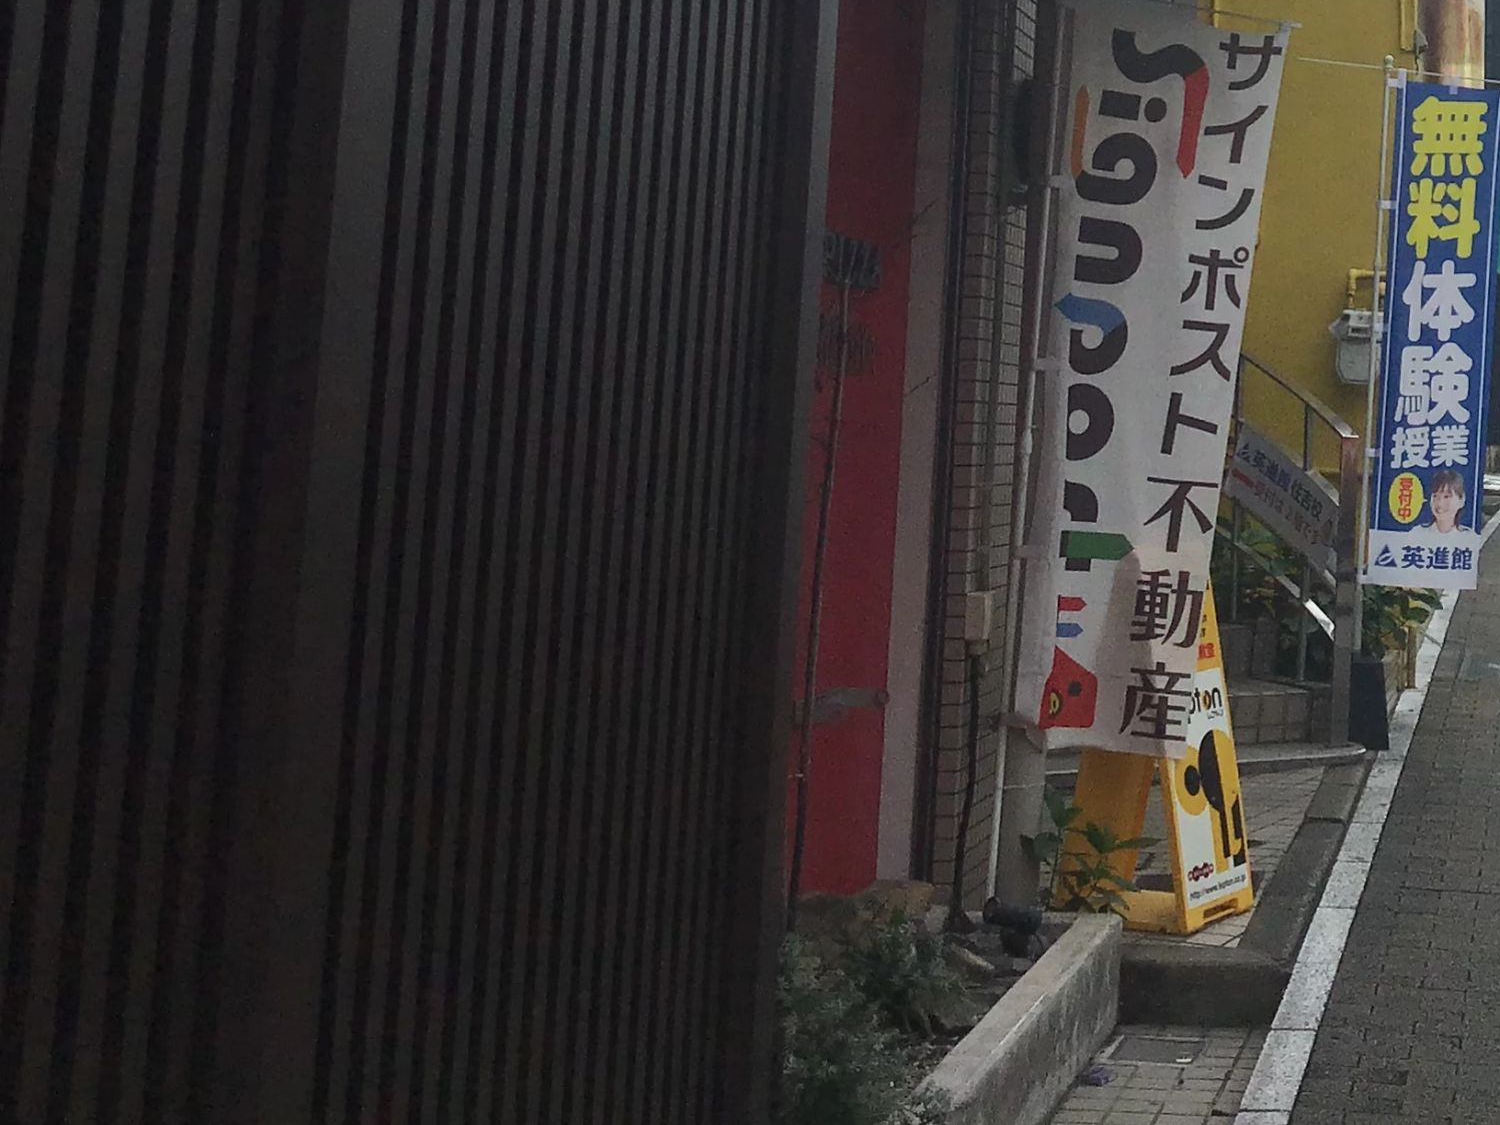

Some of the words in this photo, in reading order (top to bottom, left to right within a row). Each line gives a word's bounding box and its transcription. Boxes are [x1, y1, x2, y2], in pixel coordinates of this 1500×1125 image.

[1118, 33, 1283, 742] サインポスト不動産
[1390, 425, 1470, 469] 授業
[1397, 477, 1414, 521] 受付中
[1401, 545, 1473, 570] 英進館
